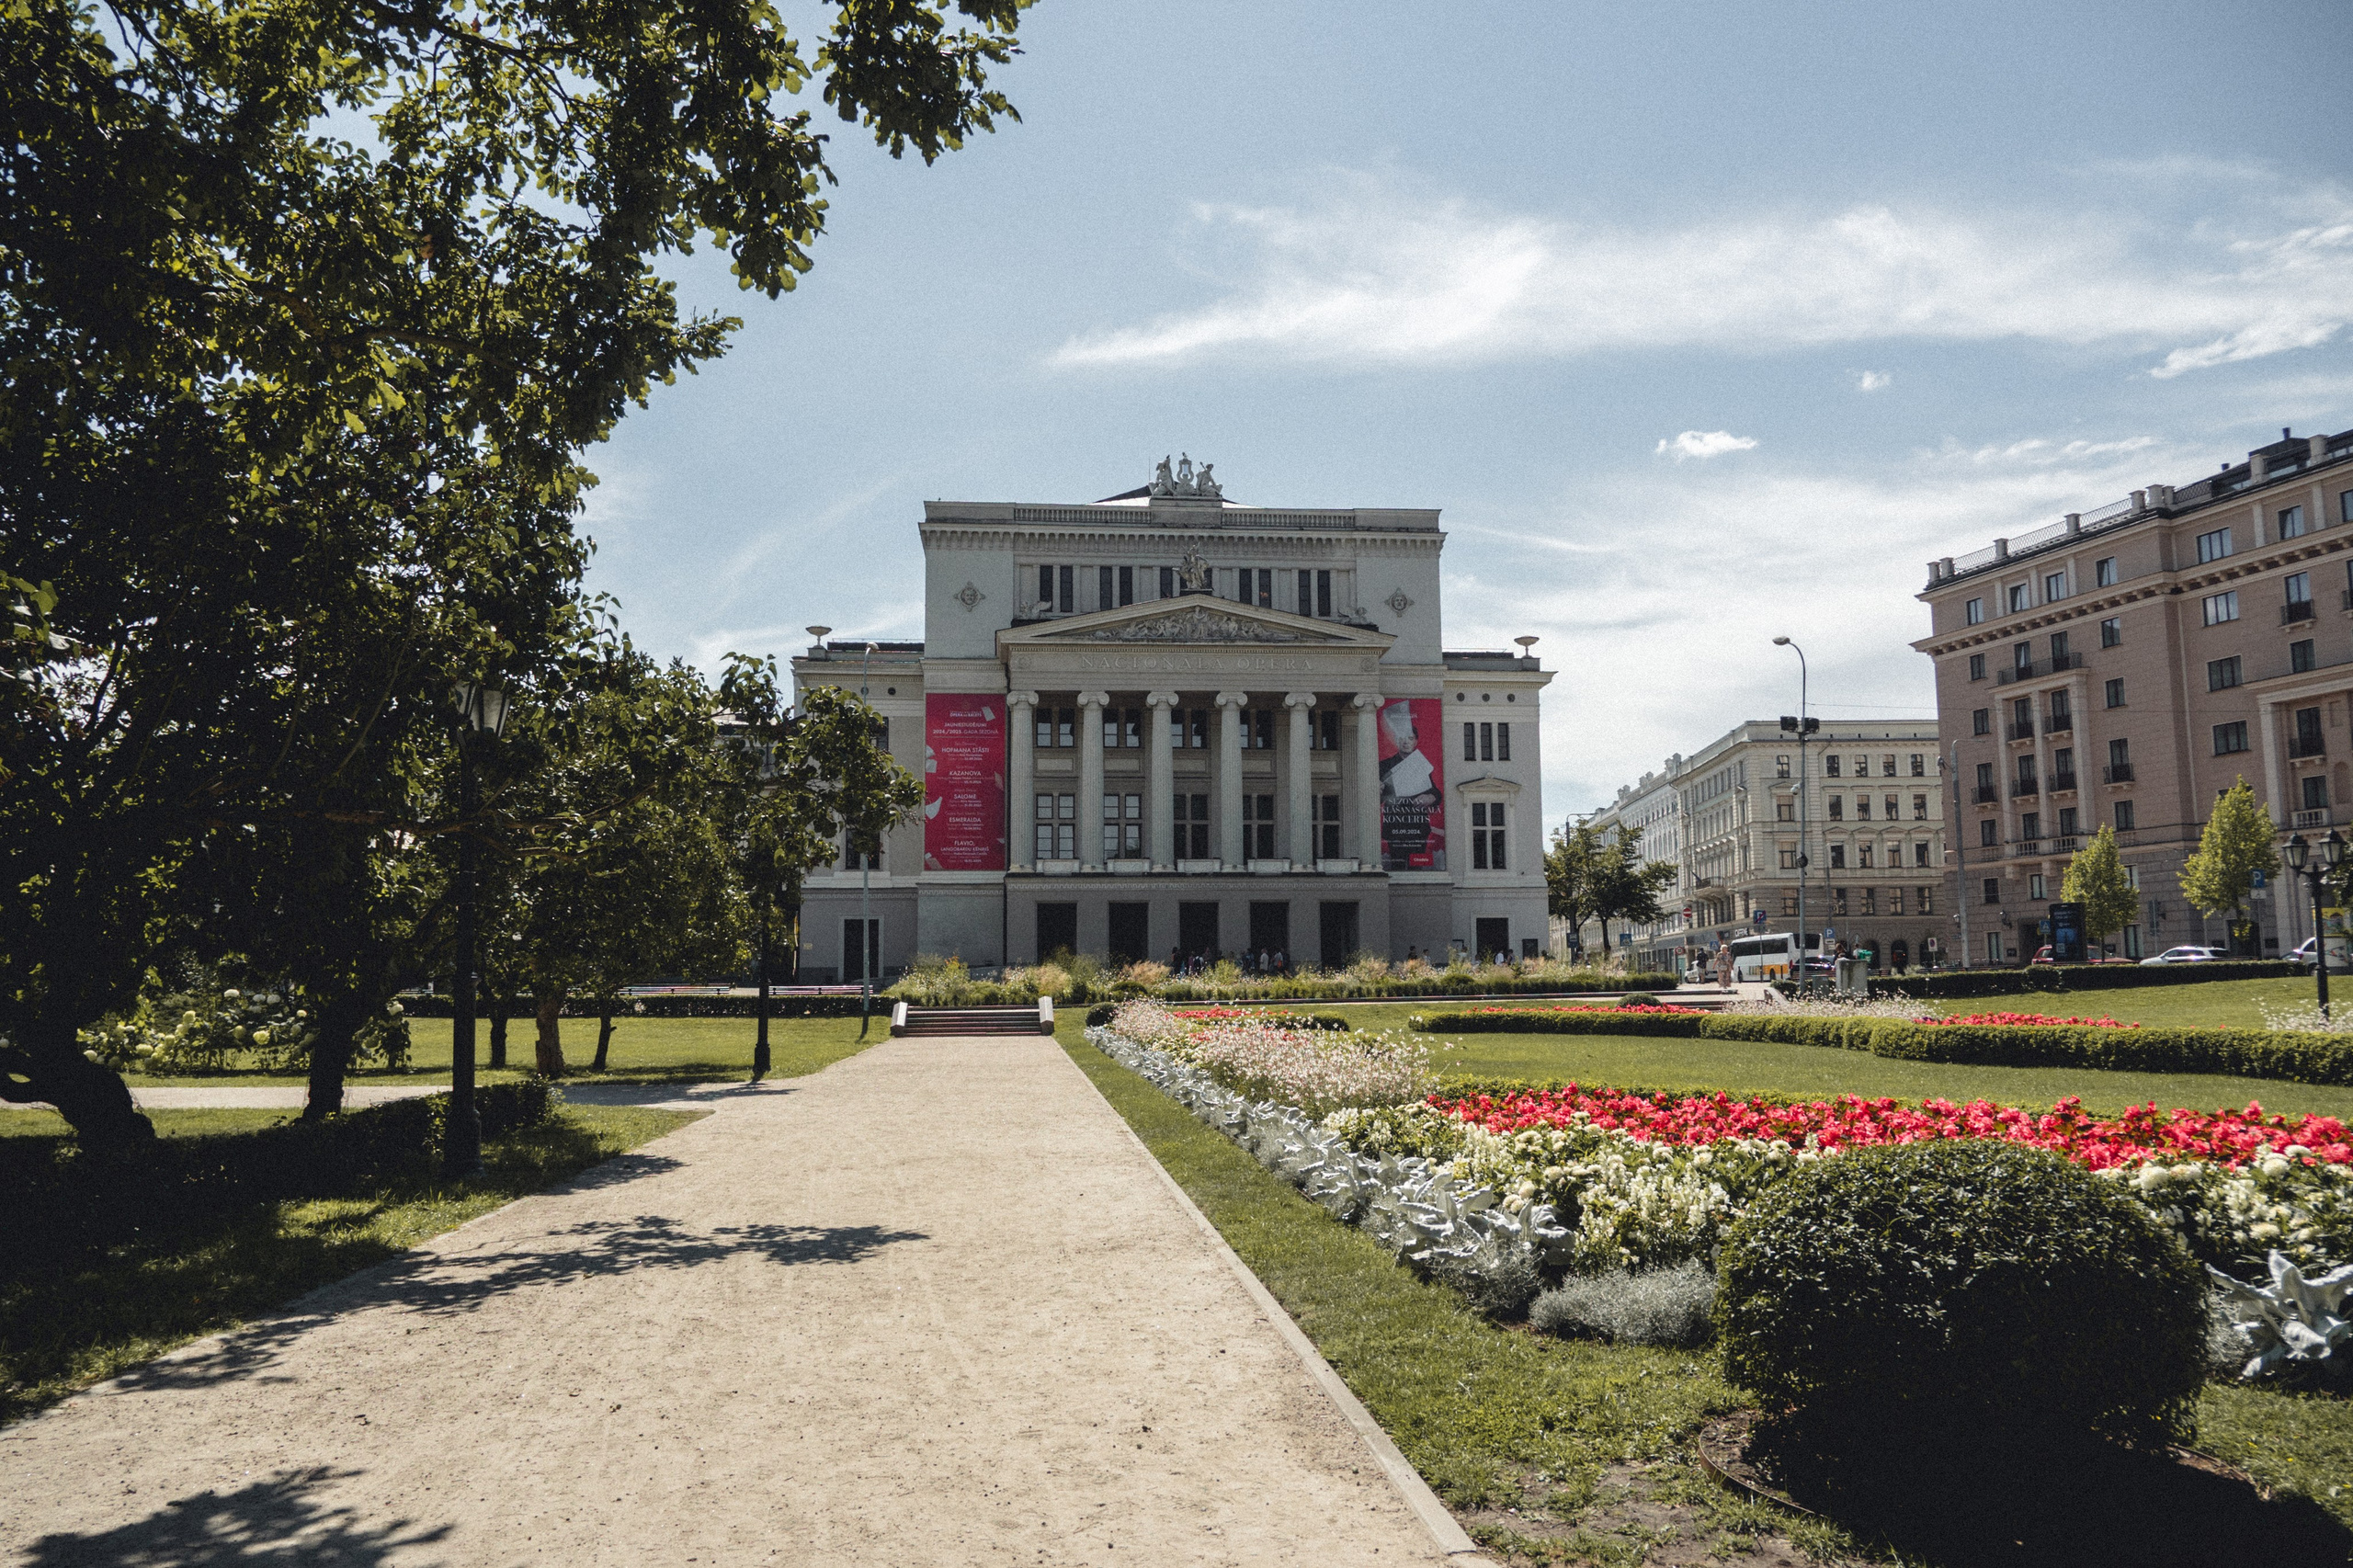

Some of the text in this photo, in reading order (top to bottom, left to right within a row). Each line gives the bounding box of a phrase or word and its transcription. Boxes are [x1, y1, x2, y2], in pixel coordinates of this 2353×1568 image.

[1237, 656, 1313, 670] OPERA
[1382, 815, 1430, 824] KONCERTS
[2252, 871, 2261, 885] P
[1826, 928, 1833, 937] P
